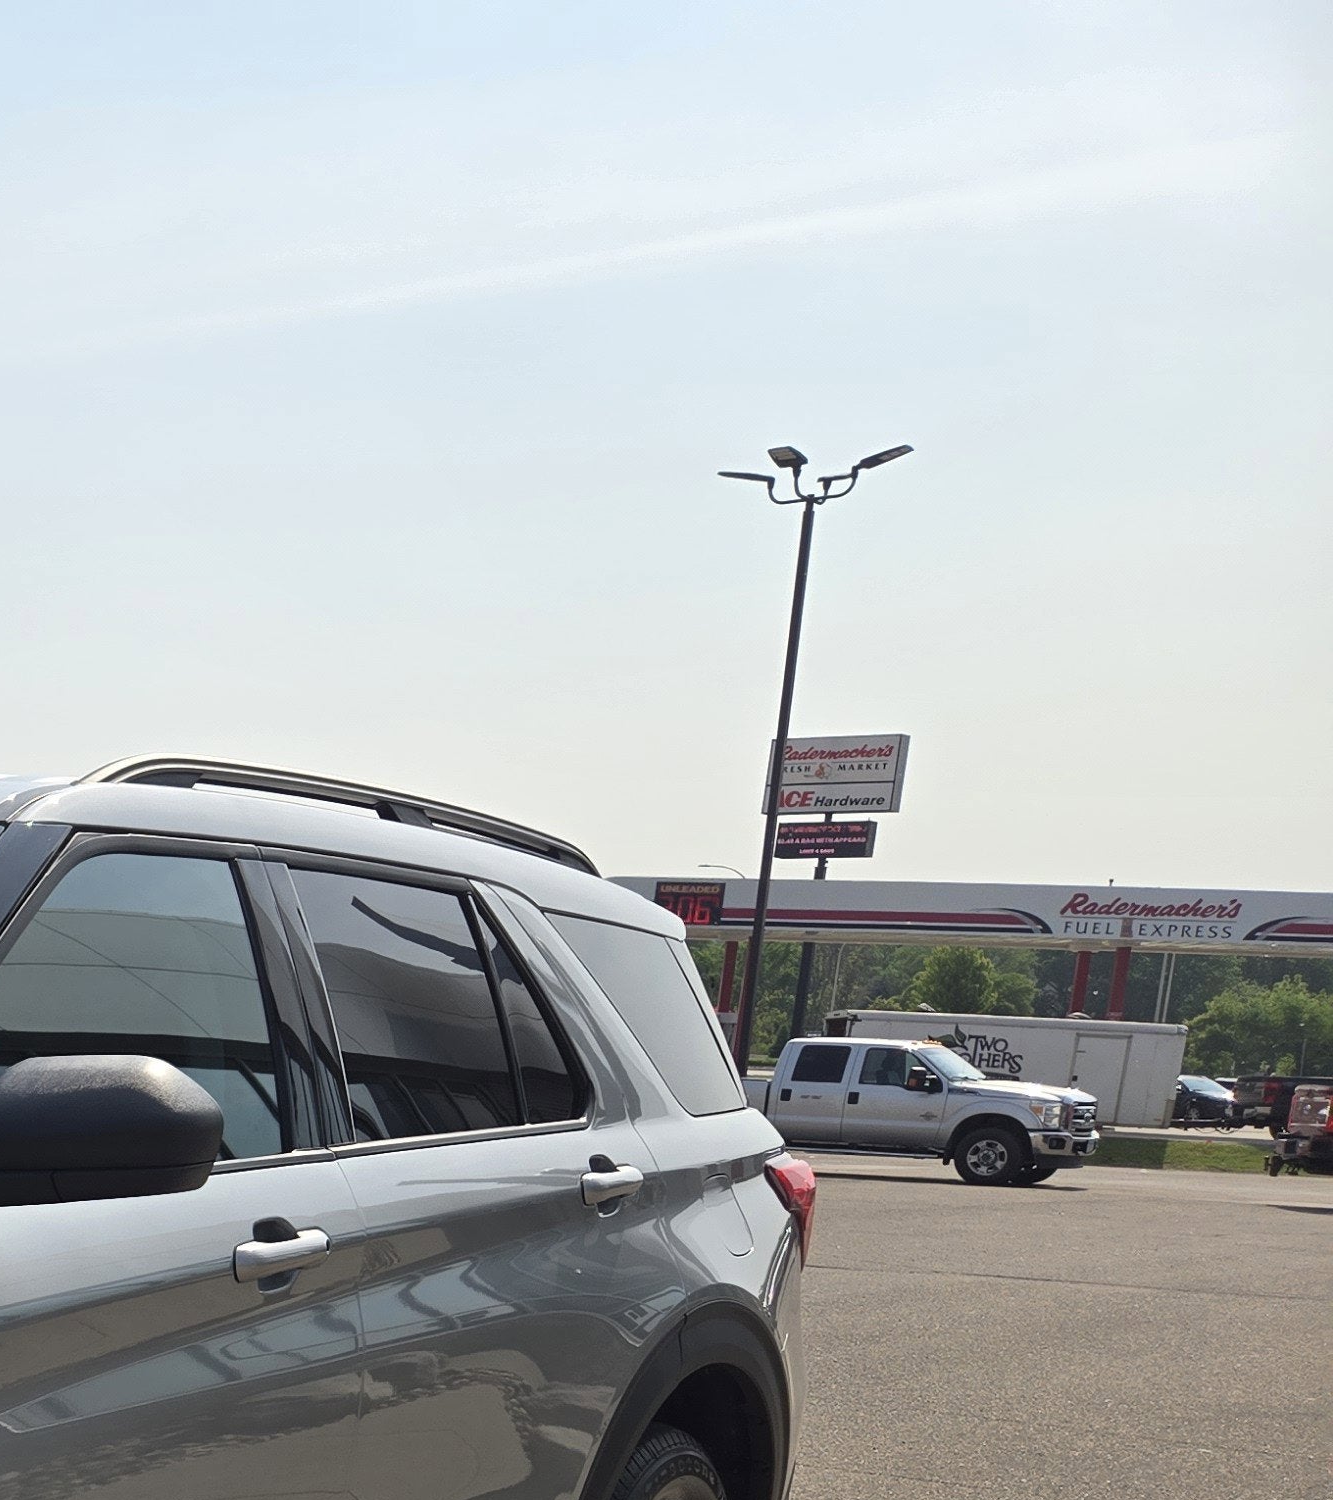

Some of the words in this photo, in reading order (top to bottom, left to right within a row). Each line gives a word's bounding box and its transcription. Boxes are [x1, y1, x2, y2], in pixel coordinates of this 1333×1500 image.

[837, 763, 888, 771] MARKET
[814, 796, 885, 807] Hardware
[660, 884, 720, 893] UNLEADED
[1060, 893, 1242, 919] Radermacher's
[1063, 921, 1114, 935] FUEL
[1138, 924, 1232, 939] EXPRESS
[968, 1034, 1008, 1060] TWO
